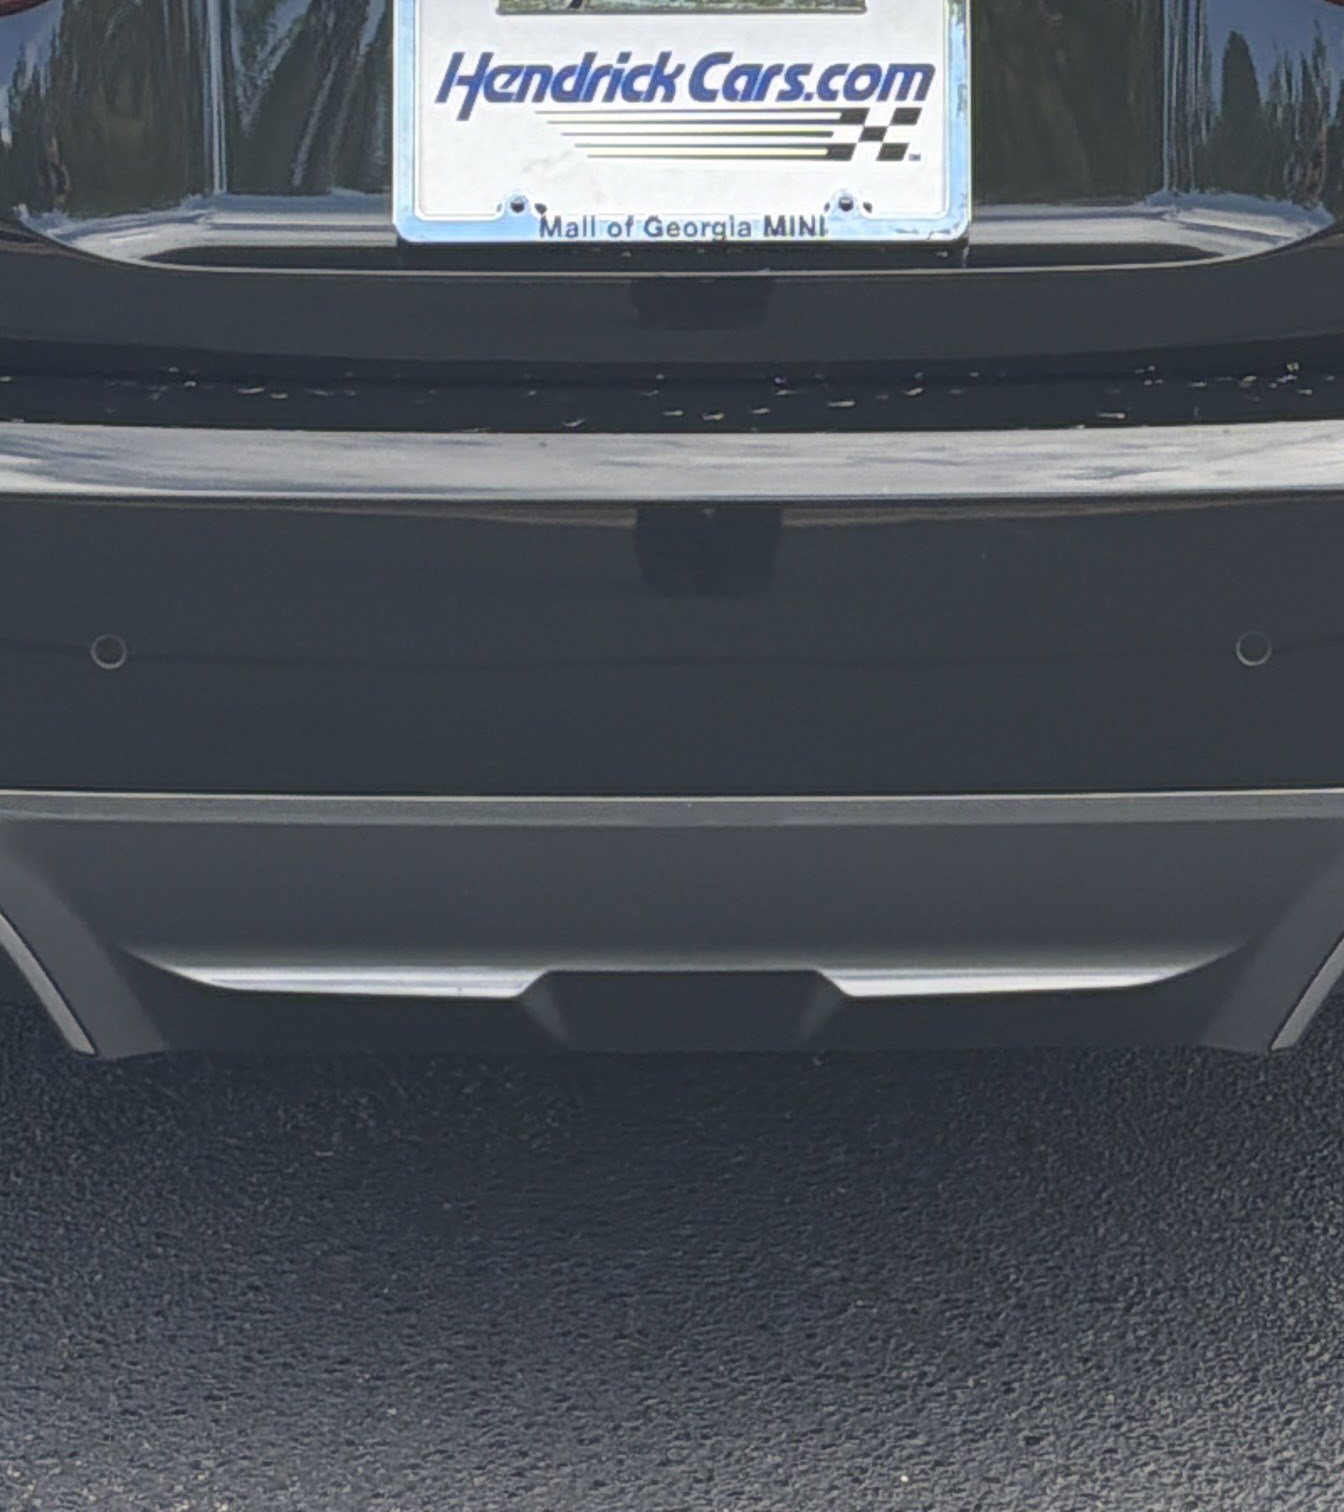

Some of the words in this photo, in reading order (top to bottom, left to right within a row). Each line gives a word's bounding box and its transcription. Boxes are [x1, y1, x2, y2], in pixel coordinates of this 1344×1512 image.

[539, 214, 596, 238] Mall
[606, 214, 635, 238] of
[642, 214, 753, 242] Georgia
[762, 214, 827, 238] MINI
